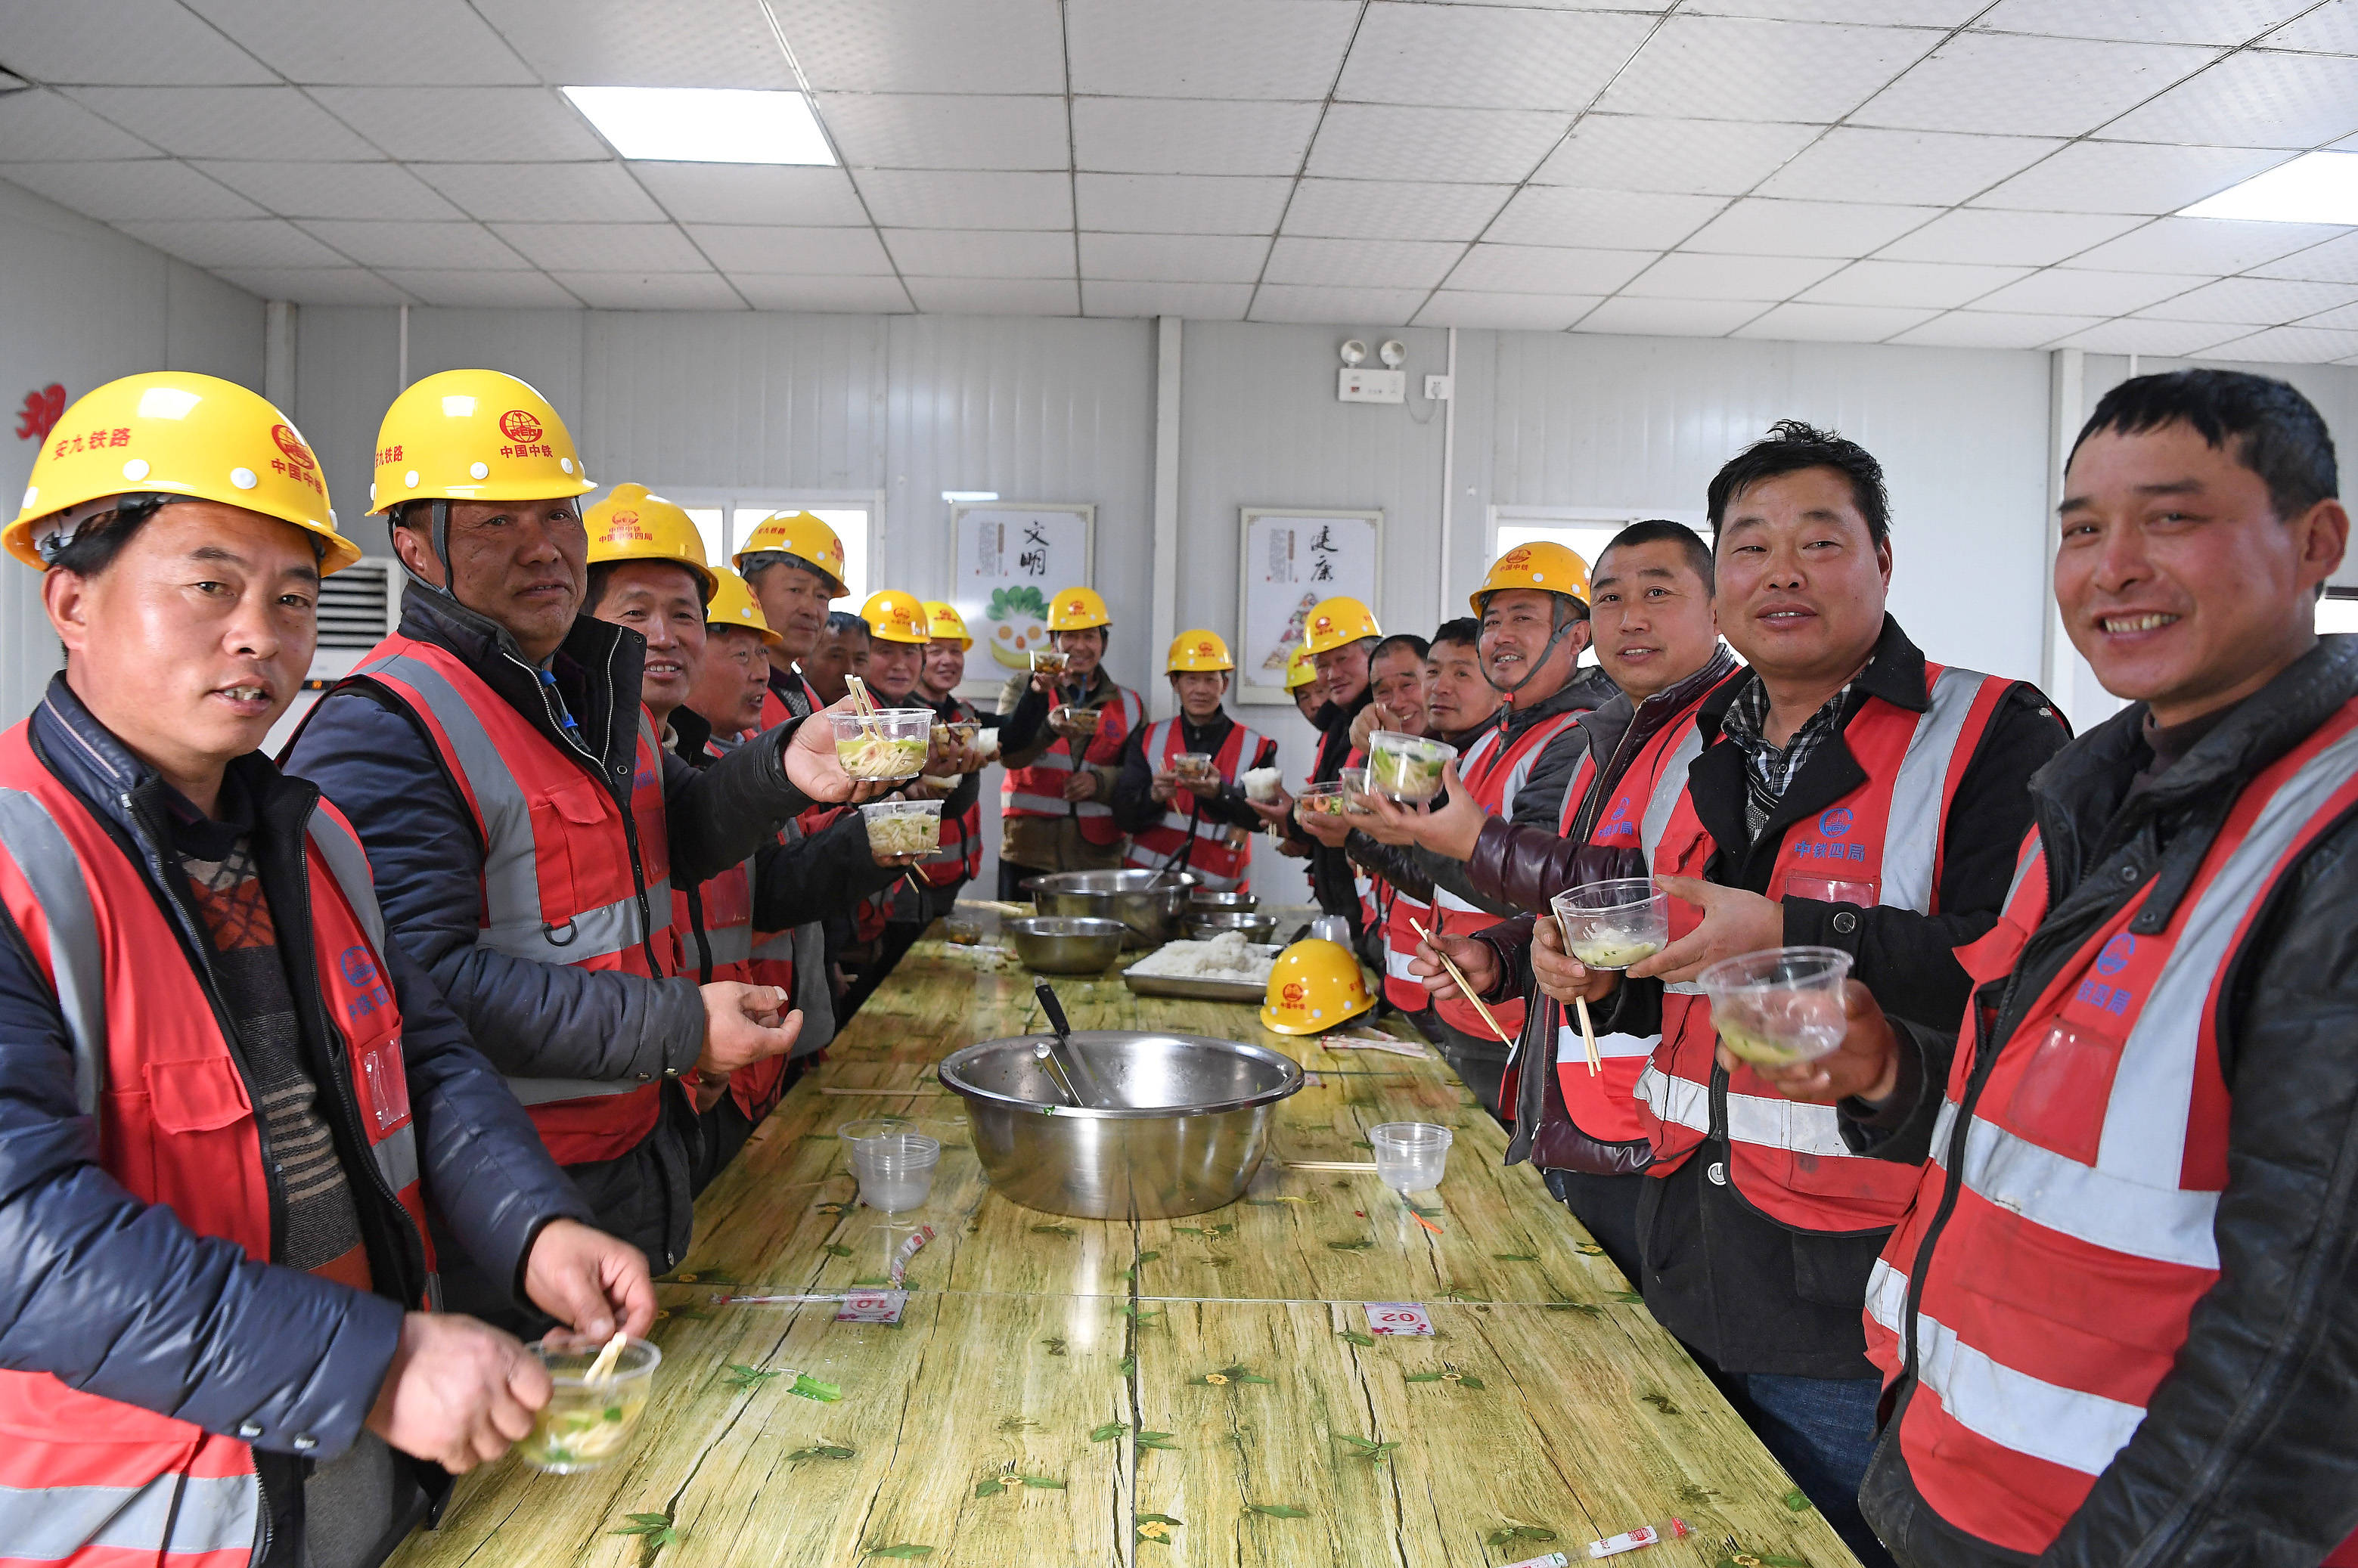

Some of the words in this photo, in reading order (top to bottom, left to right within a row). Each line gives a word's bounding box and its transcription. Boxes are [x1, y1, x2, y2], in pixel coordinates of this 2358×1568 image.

[53, 428, 131, 461] 安九铁路
[500, 445, 554, 459] 中国中铁
[271, 458, 324, 497] 中国中铁
[1020, 520, 1050, 576] 文明
[1311, 525, 1339, 581] 健康
[1795, 840, 1865, 863] 中铁四局
[1379, 1312, 1415, 1322] 02
